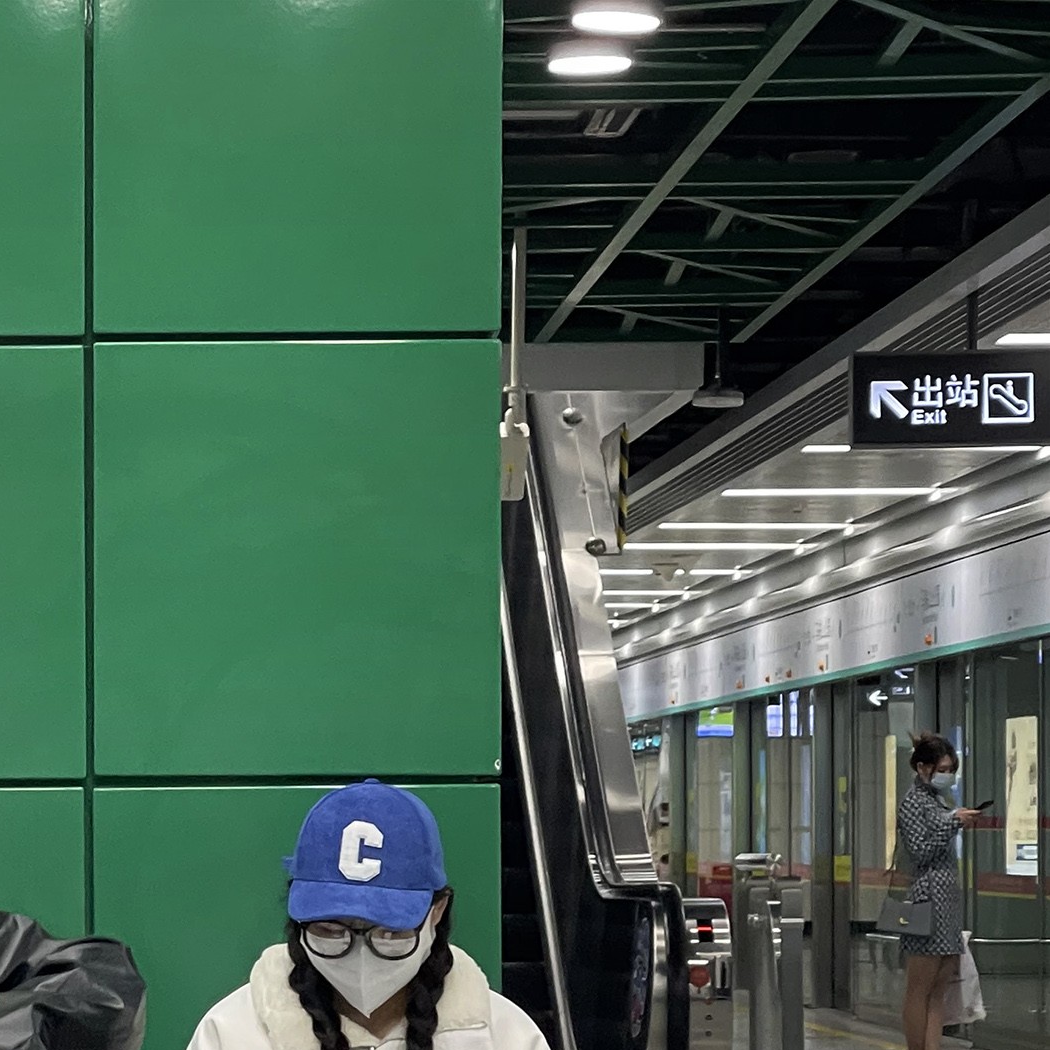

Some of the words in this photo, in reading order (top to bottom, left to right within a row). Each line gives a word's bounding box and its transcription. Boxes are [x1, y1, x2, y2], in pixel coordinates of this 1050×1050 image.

[912, 373, 980, 408] 出站
[910, 409, 947, 425] Exit
[338, 820, 384, 882] C
